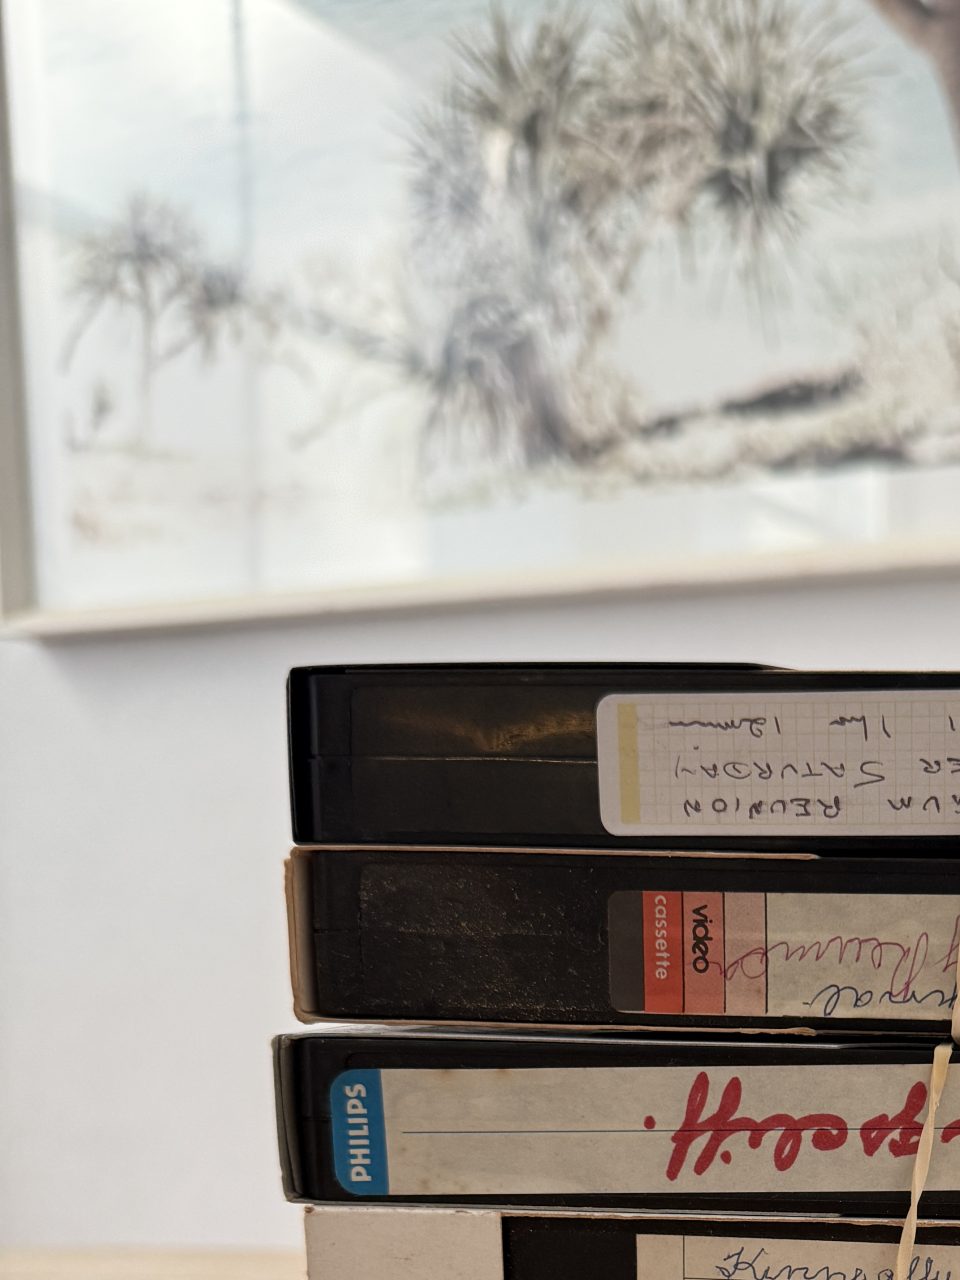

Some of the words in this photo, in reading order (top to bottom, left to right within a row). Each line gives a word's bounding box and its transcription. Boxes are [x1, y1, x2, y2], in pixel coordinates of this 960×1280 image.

[674, 755, 886, 788] SATURDAY
[682, 796, 841, 819] REUNION
[654, 895, 671, 980] cassette
[691, 904, 713, 974] video
[344, 1083, 373, 1182] PHILIPS
